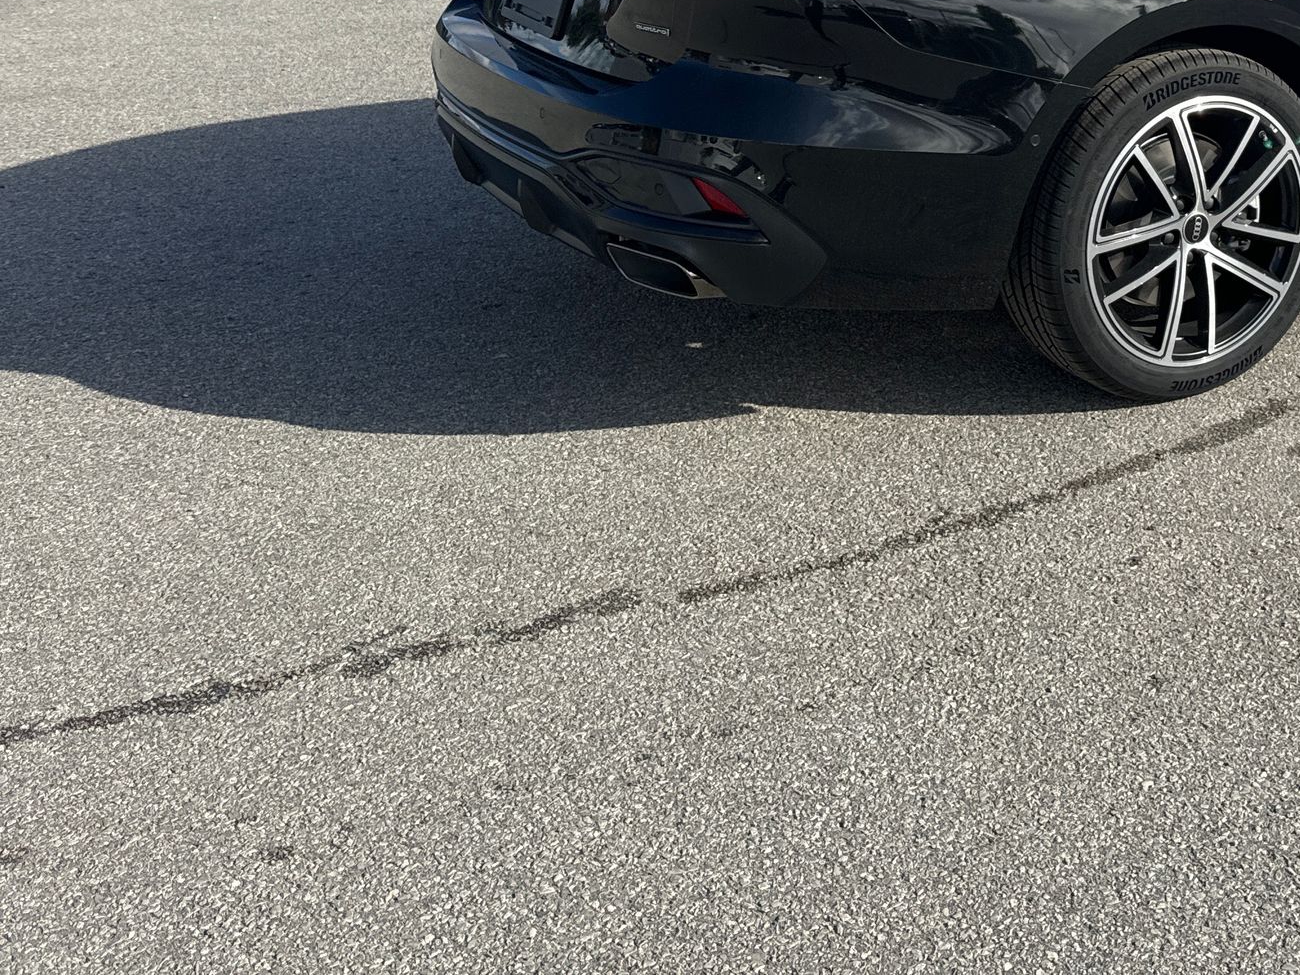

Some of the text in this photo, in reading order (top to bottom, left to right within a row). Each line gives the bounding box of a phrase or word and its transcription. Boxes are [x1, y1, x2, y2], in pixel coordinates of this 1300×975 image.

[635, 24, 670, 36] quattro
[1142, 71, 1241, 111] BRIDGESTONE
[1169, 345, 1264, 392] BRIDGESTONE
